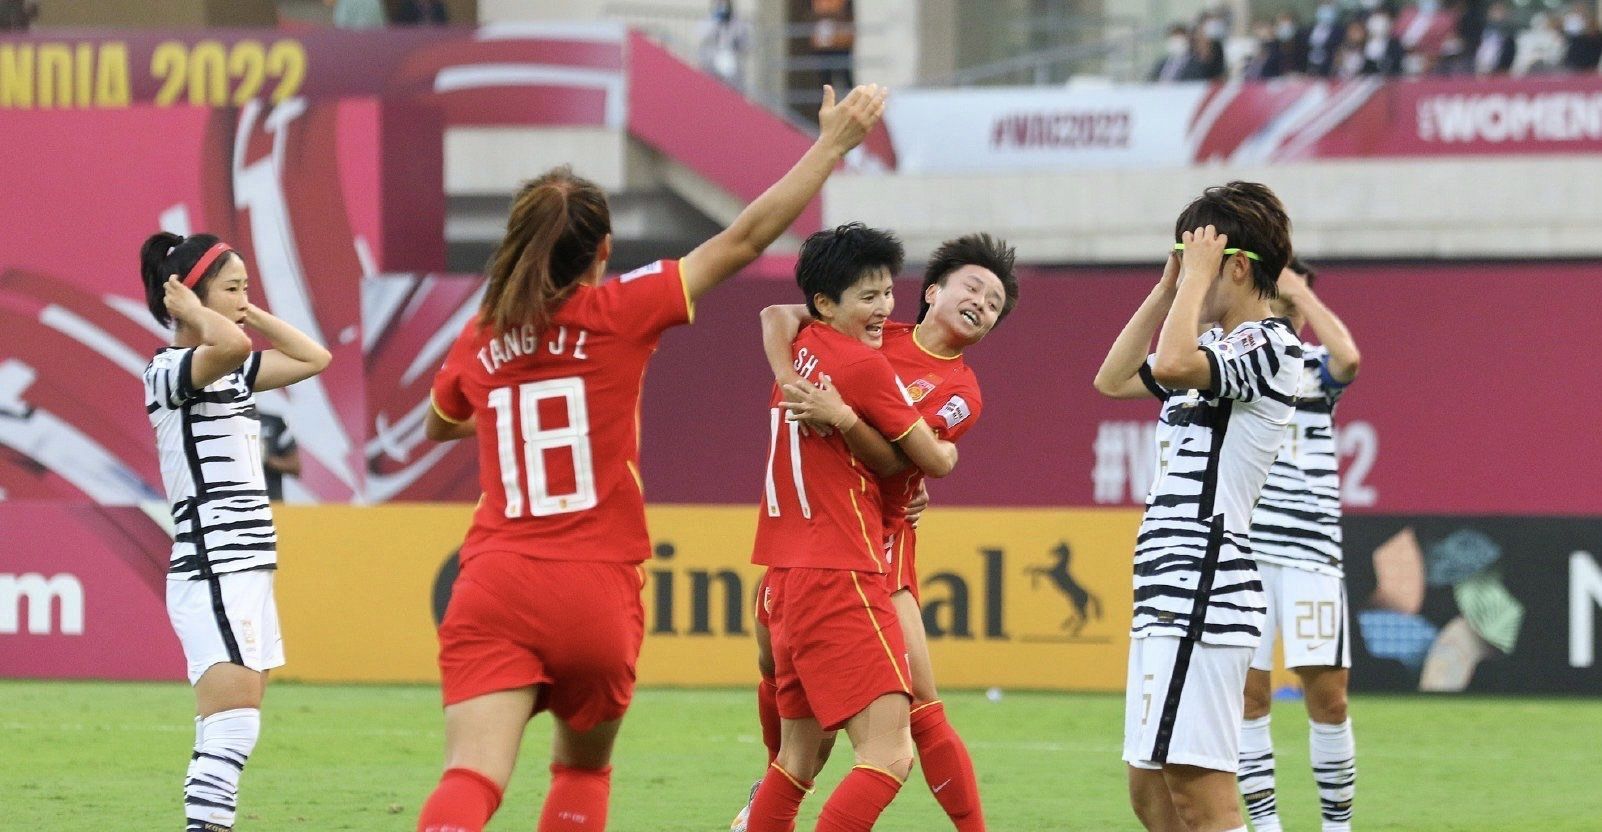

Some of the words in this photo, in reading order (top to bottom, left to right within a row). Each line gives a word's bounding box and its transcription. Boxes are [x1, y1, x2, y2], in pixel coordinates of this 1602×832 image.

[0, 42, 130, 107] NDIA
[152, 40, 305, 107] 2022
[477, 324, 537, 374] TANG
[488, 377, 597, 518] 18
[1295, 601, 1335, 639] 20
